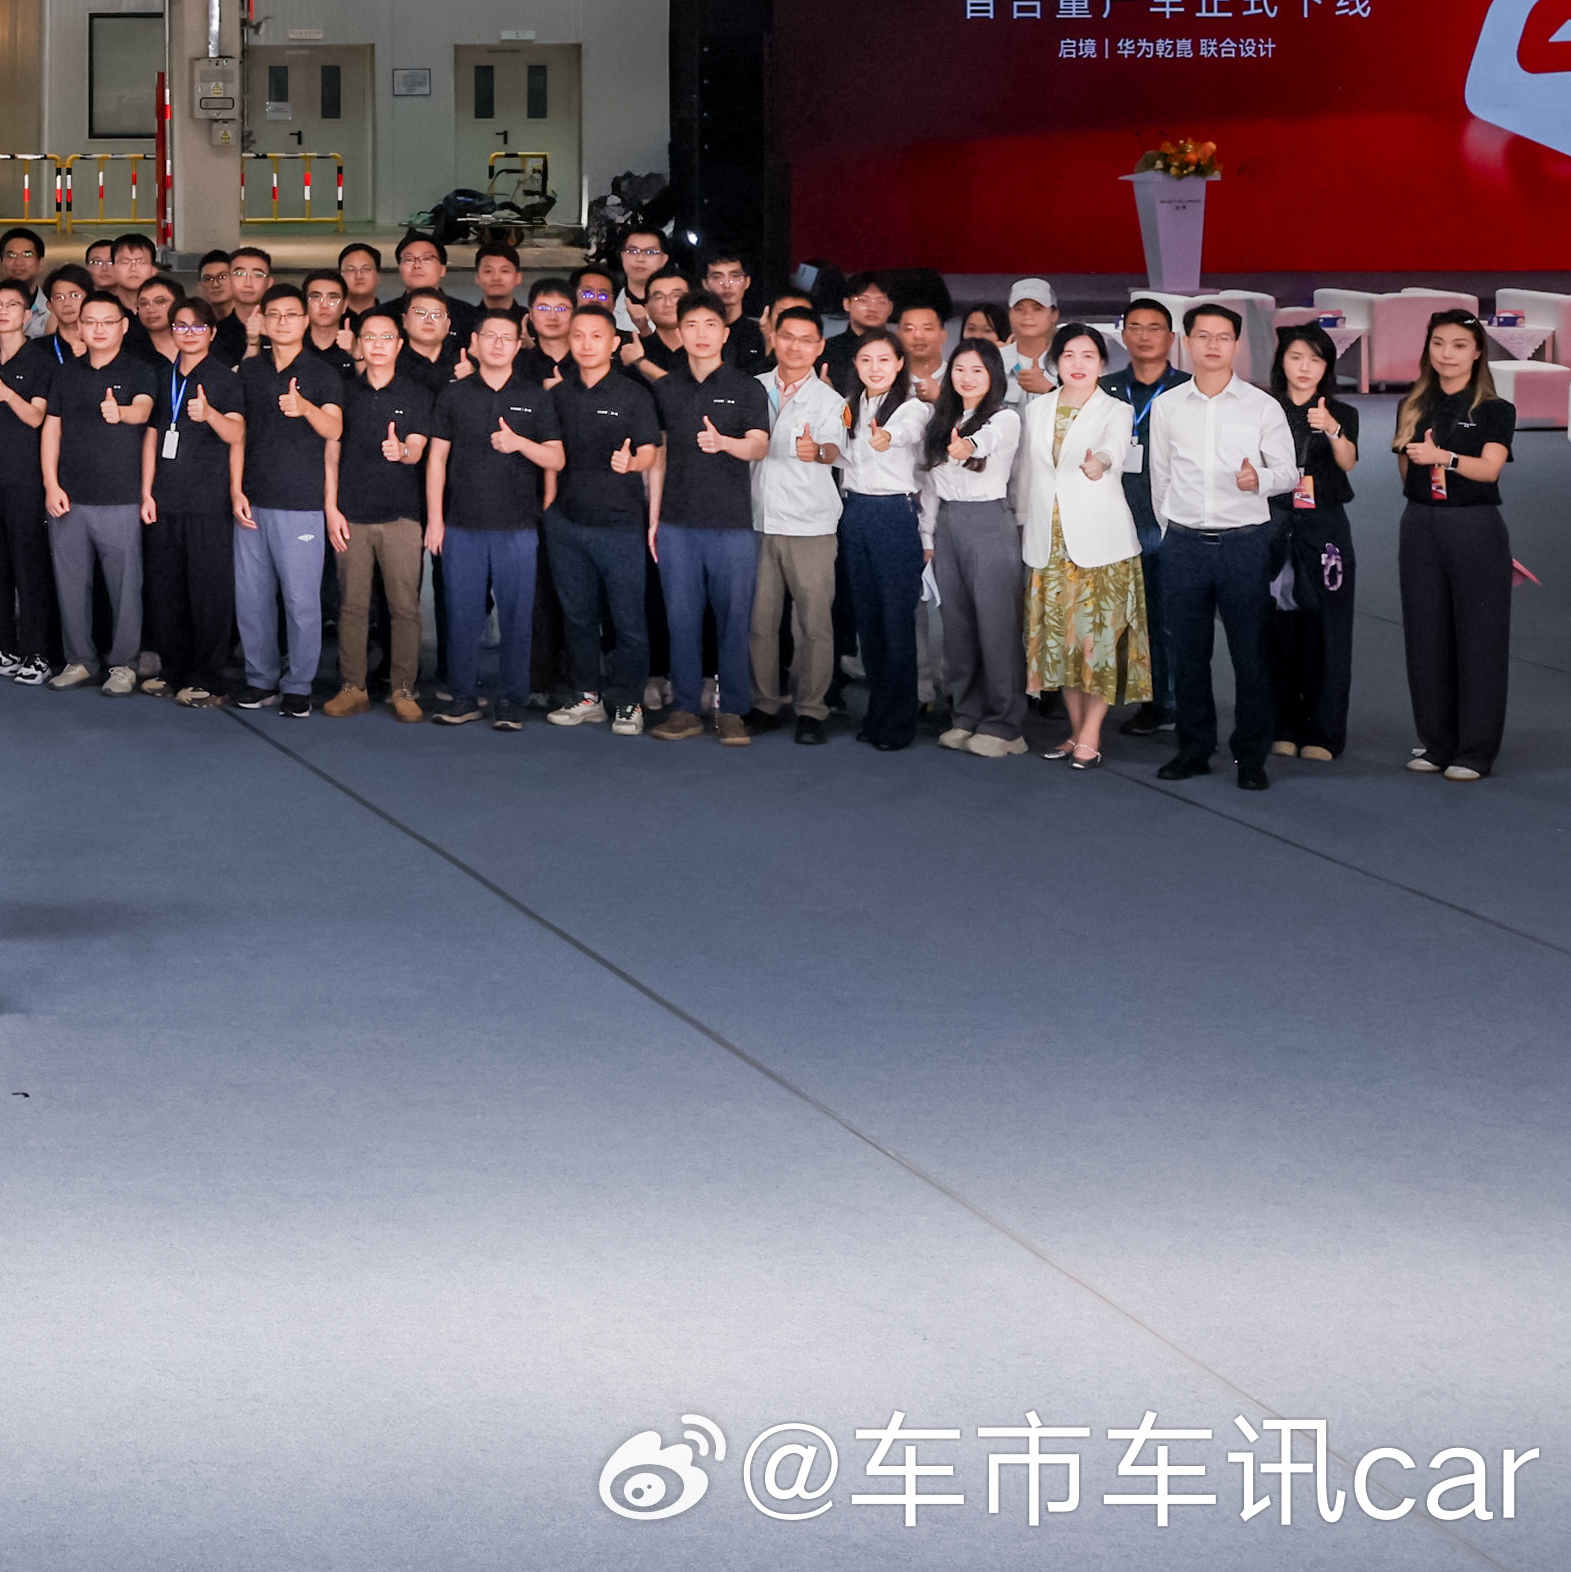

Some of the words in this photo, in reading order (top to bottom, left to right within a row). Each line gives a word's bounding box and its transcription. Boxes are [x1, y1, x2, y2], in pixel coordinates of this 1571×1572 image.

[1057, 37, 1098, 59] 启境
[1116, 37, 1194, 59] 华为乾崑
[1199, 37, 1277, 59] 联合设计
